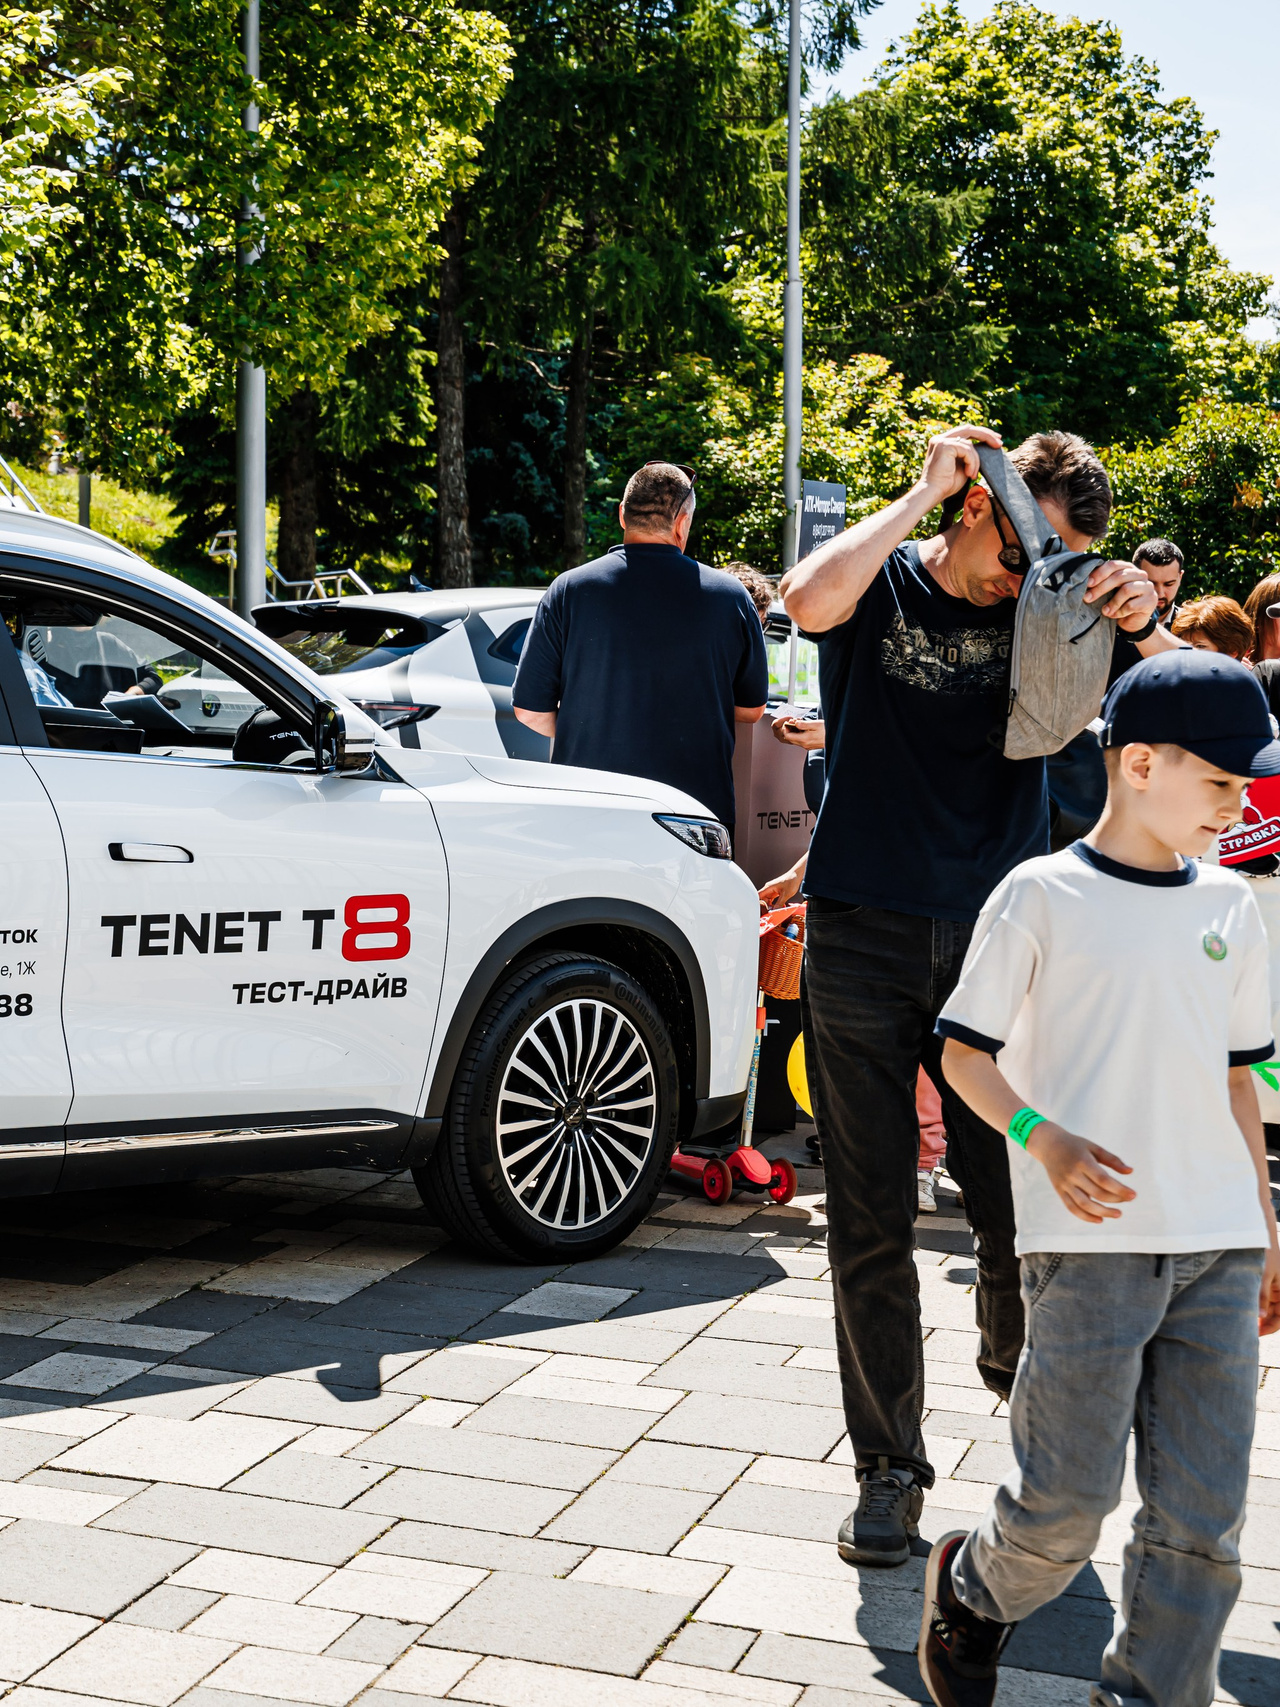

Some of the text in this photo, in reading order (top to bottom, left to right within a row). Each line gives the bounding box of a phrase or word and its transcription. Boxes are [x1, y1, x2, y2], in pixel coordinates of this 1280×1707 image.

[934, 643, 1010, 664] HORIZO
[756, 809, 812, 830] TENET
[100, 893, 411, 962] TENET T8
[16, 960, 37, 976] 1Ж
[232, 974, 408, 1006] ТЕСТ-ДРАЙВ
[614, 982, 667, 1049] Continental
[479, 1010, 527, 1118] PremiumContact
